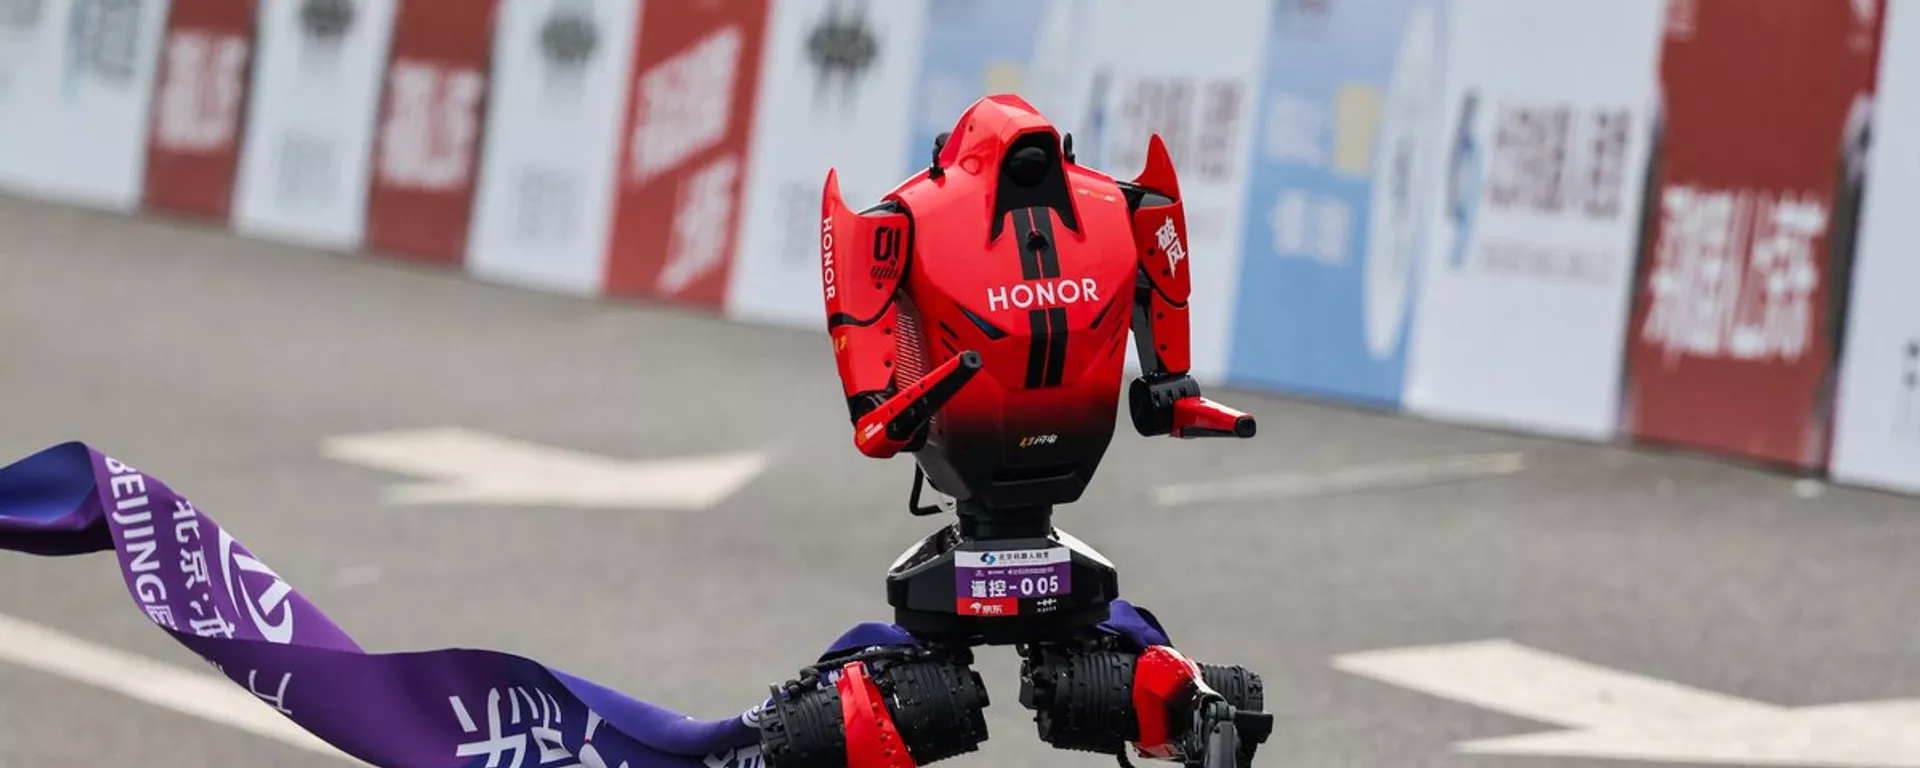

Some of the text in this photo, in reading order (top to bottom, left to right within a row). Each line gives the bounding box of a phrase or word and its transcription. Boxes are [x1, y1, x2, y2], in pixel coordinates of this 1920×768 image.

[823, 217, 836, 300] HONOR
[1155, 215, 1186, 279] 破风
[987, 277, 1100, 312] HONOR
[970, 575, 1058, 597] 遥控-005
